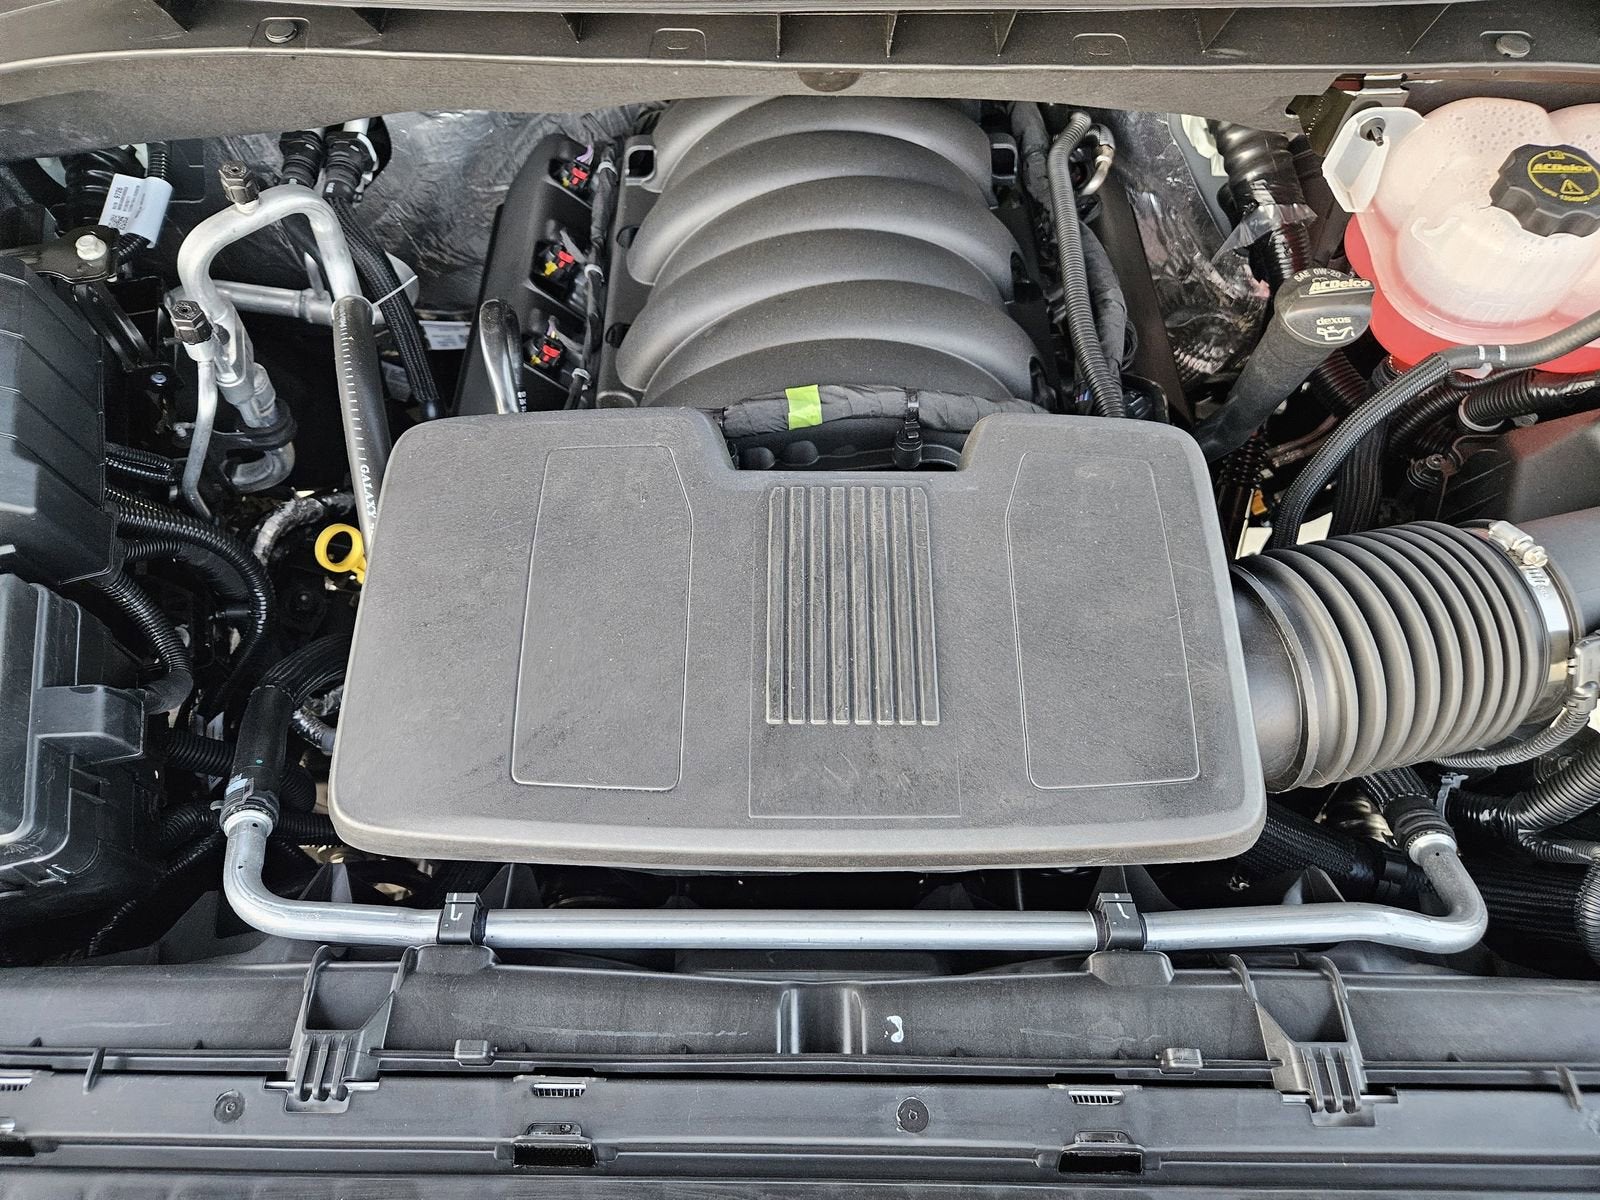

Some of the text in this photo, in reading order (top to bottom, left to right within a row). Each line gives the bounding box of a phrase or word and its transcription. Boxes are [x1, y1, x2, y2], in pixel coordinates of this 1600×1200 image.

[1532, 164, 1593, 172] ACDelco
[1294, 267, 1341, 282] SAE 0W-20
[1309, 279, 1370, 293] ACDelco
[1316, 317, 1351, 326] dexos
[360, 464, 377, 519] GALAXY
